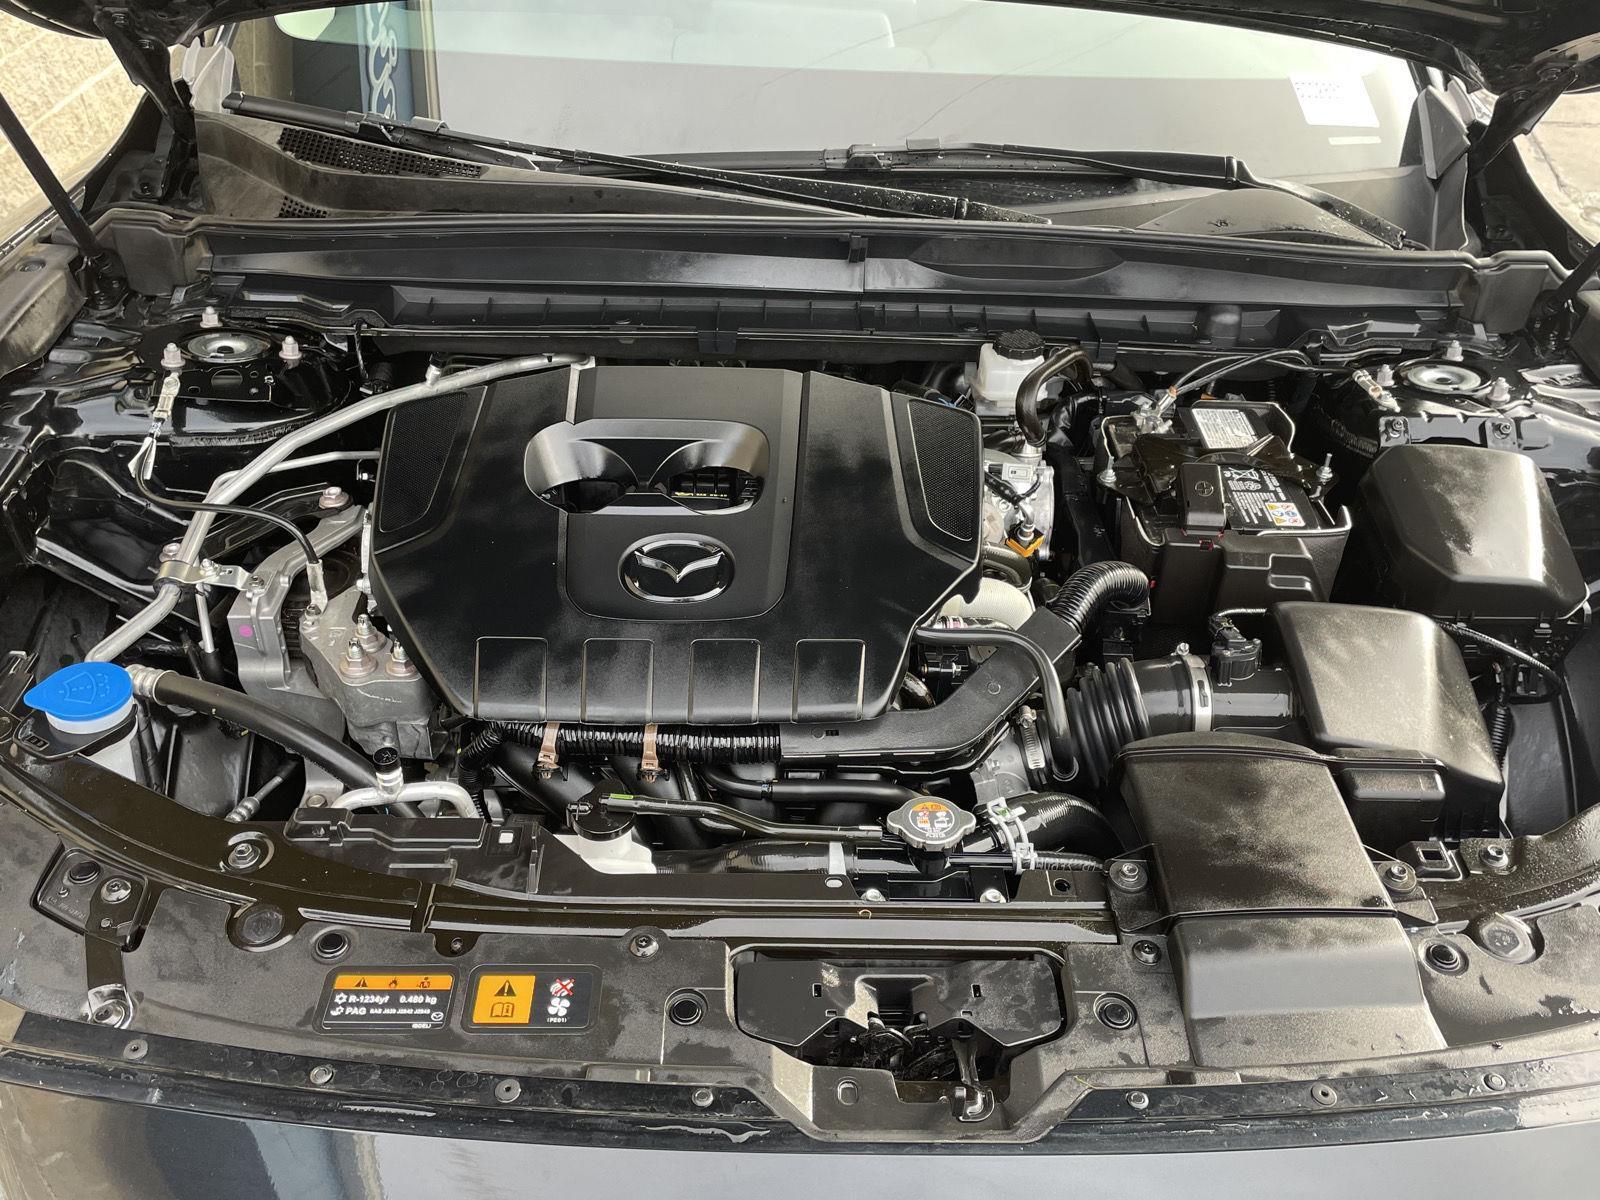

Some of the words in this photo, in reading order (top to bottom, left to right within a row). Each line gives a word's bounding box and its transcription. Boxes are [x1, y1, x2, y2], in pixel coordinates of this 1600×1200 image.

[348, 994, 390, 1005] R-1234yf
[424, 995, 437, 1005] kg
[345, 1007, 367, 1015] PAG
